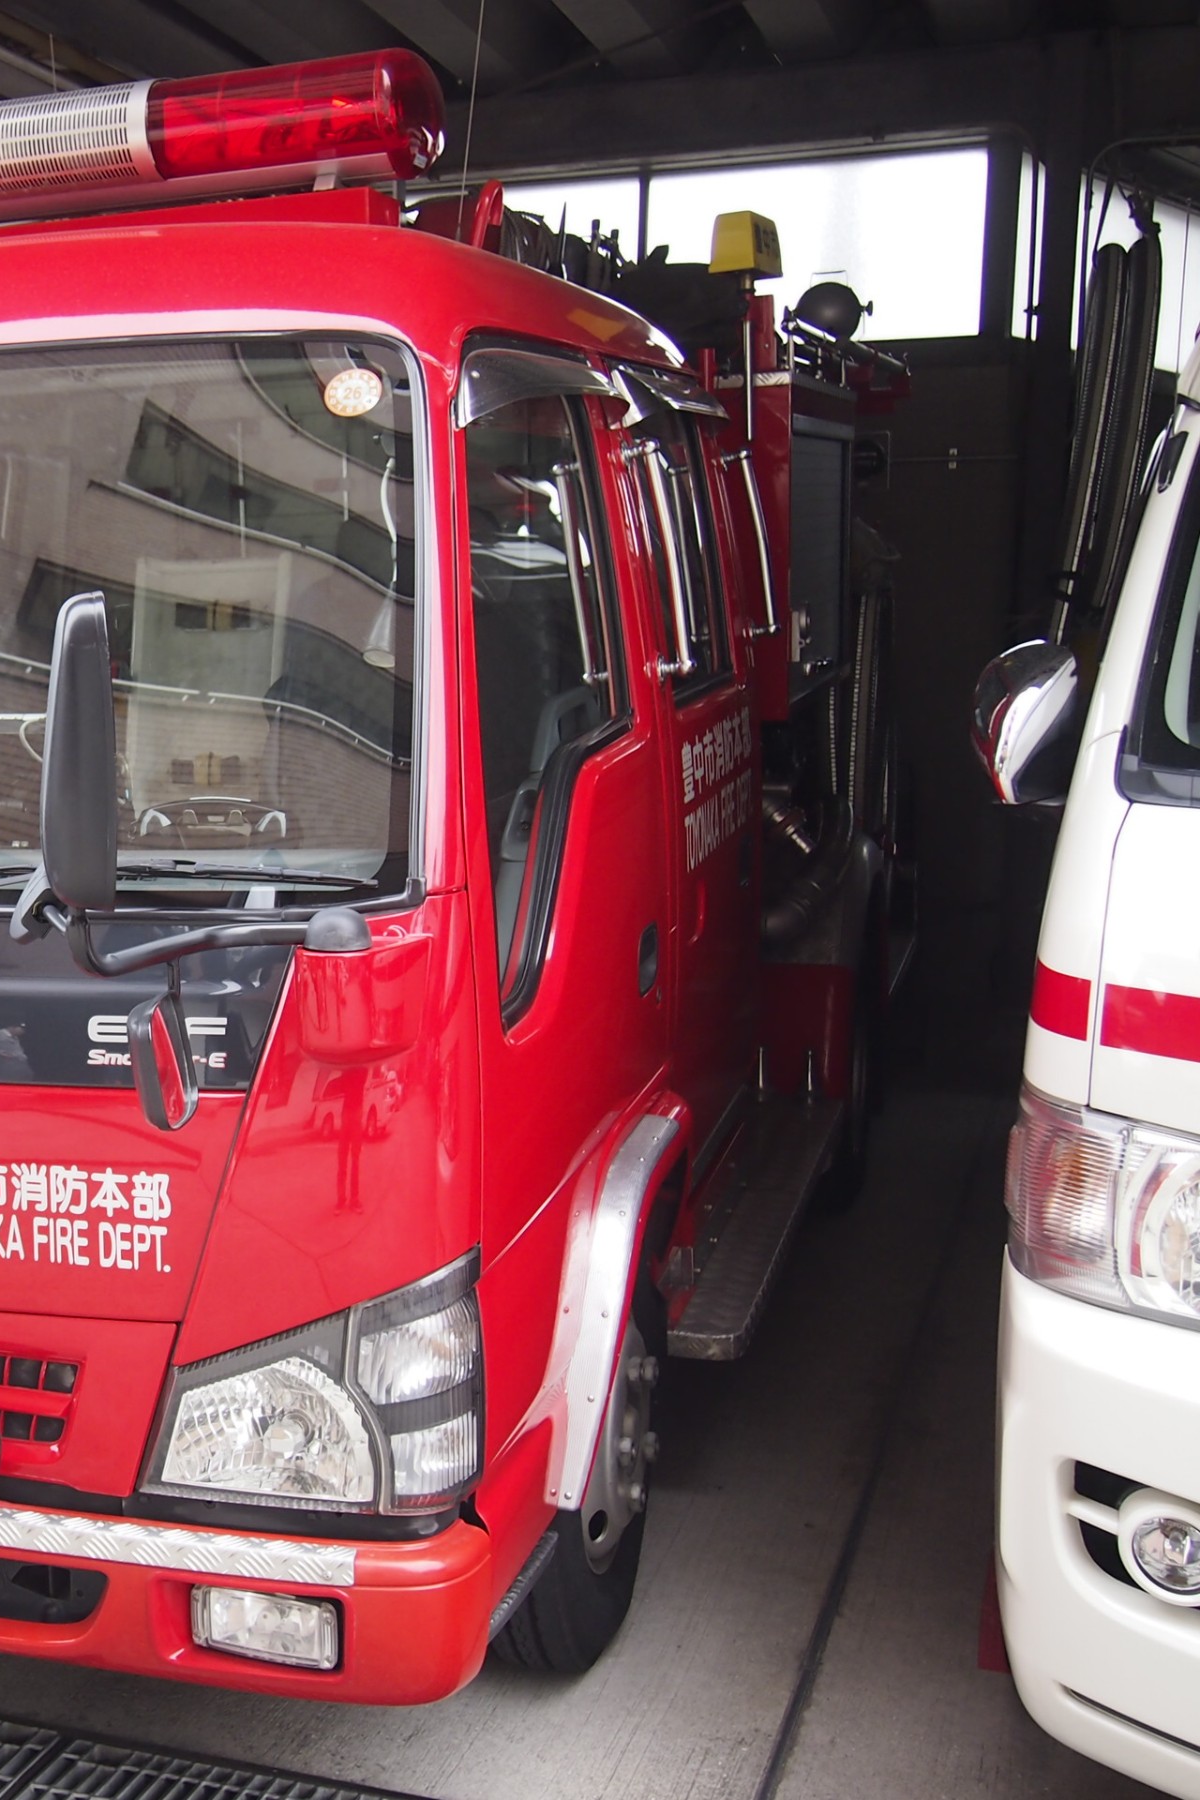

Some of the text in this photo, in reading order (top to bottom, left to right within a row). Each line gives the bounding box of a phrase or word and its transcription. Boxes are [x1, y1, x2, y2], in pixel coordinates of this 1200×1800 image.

[343, 386, 362, 400] 26
[682, 706, 750, 804] 豊中市消防本部
[684, 793, 720, 873] TOYONAKA
[87, 1015, 228, 1043] EF
[33, 1216, 90, 1266] FIRE
[99, 1221, 171, 1273] DEPT.
